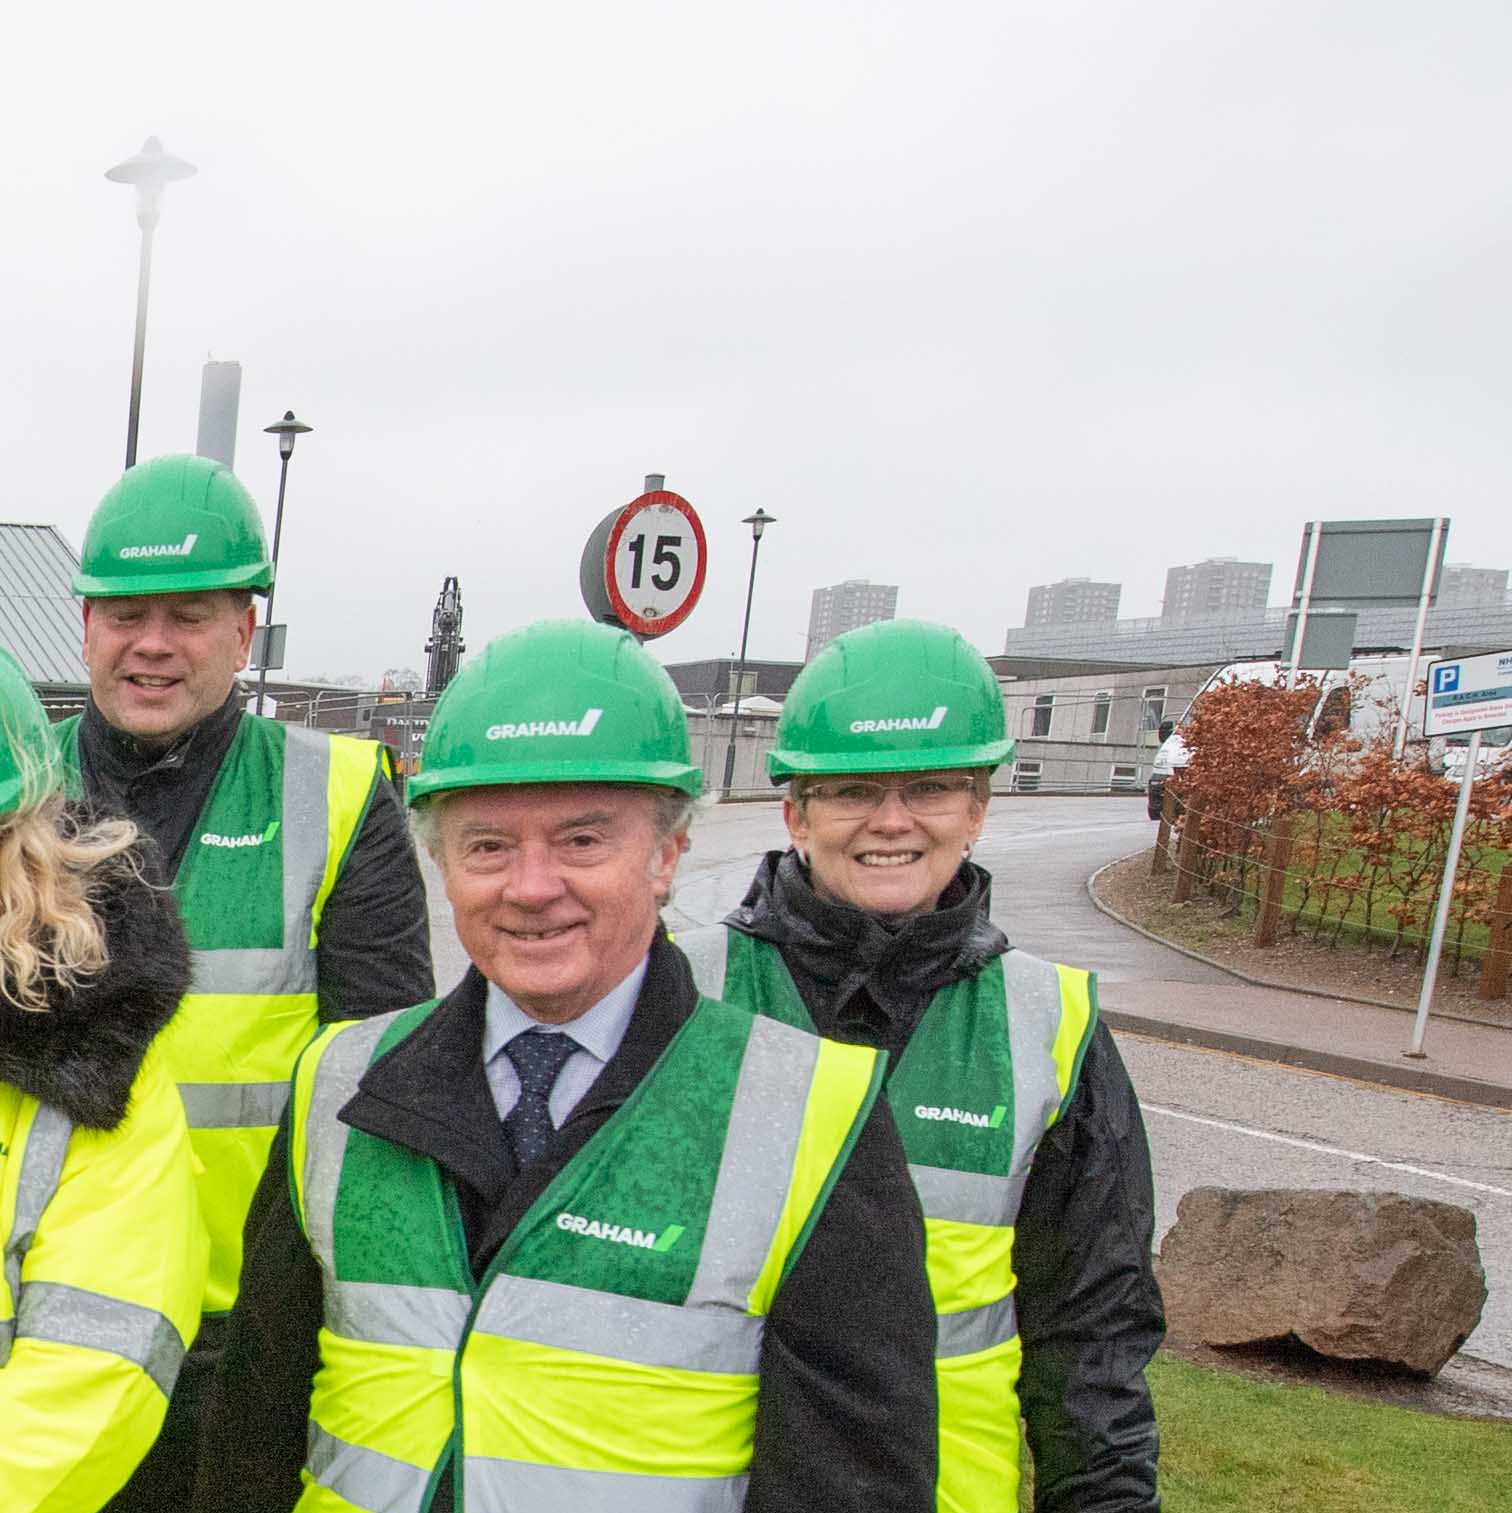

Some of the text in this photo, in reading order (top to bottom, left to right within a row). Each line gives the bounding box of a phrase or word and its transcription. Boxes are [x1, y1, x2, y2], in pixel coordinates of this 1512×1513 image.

[120, 544, 183, 559] GRAHAM
[629, 534, 682, 591] 15
[486, 719, 580, 740] GRAHAM
[850, 717, 929, 733] GRAHAM
[201, 832, 265, 849] GRAHAM
[915, 1105, 989, 1128] GRAHAM
[557, 1212, 658, 1249] GRAHAM
